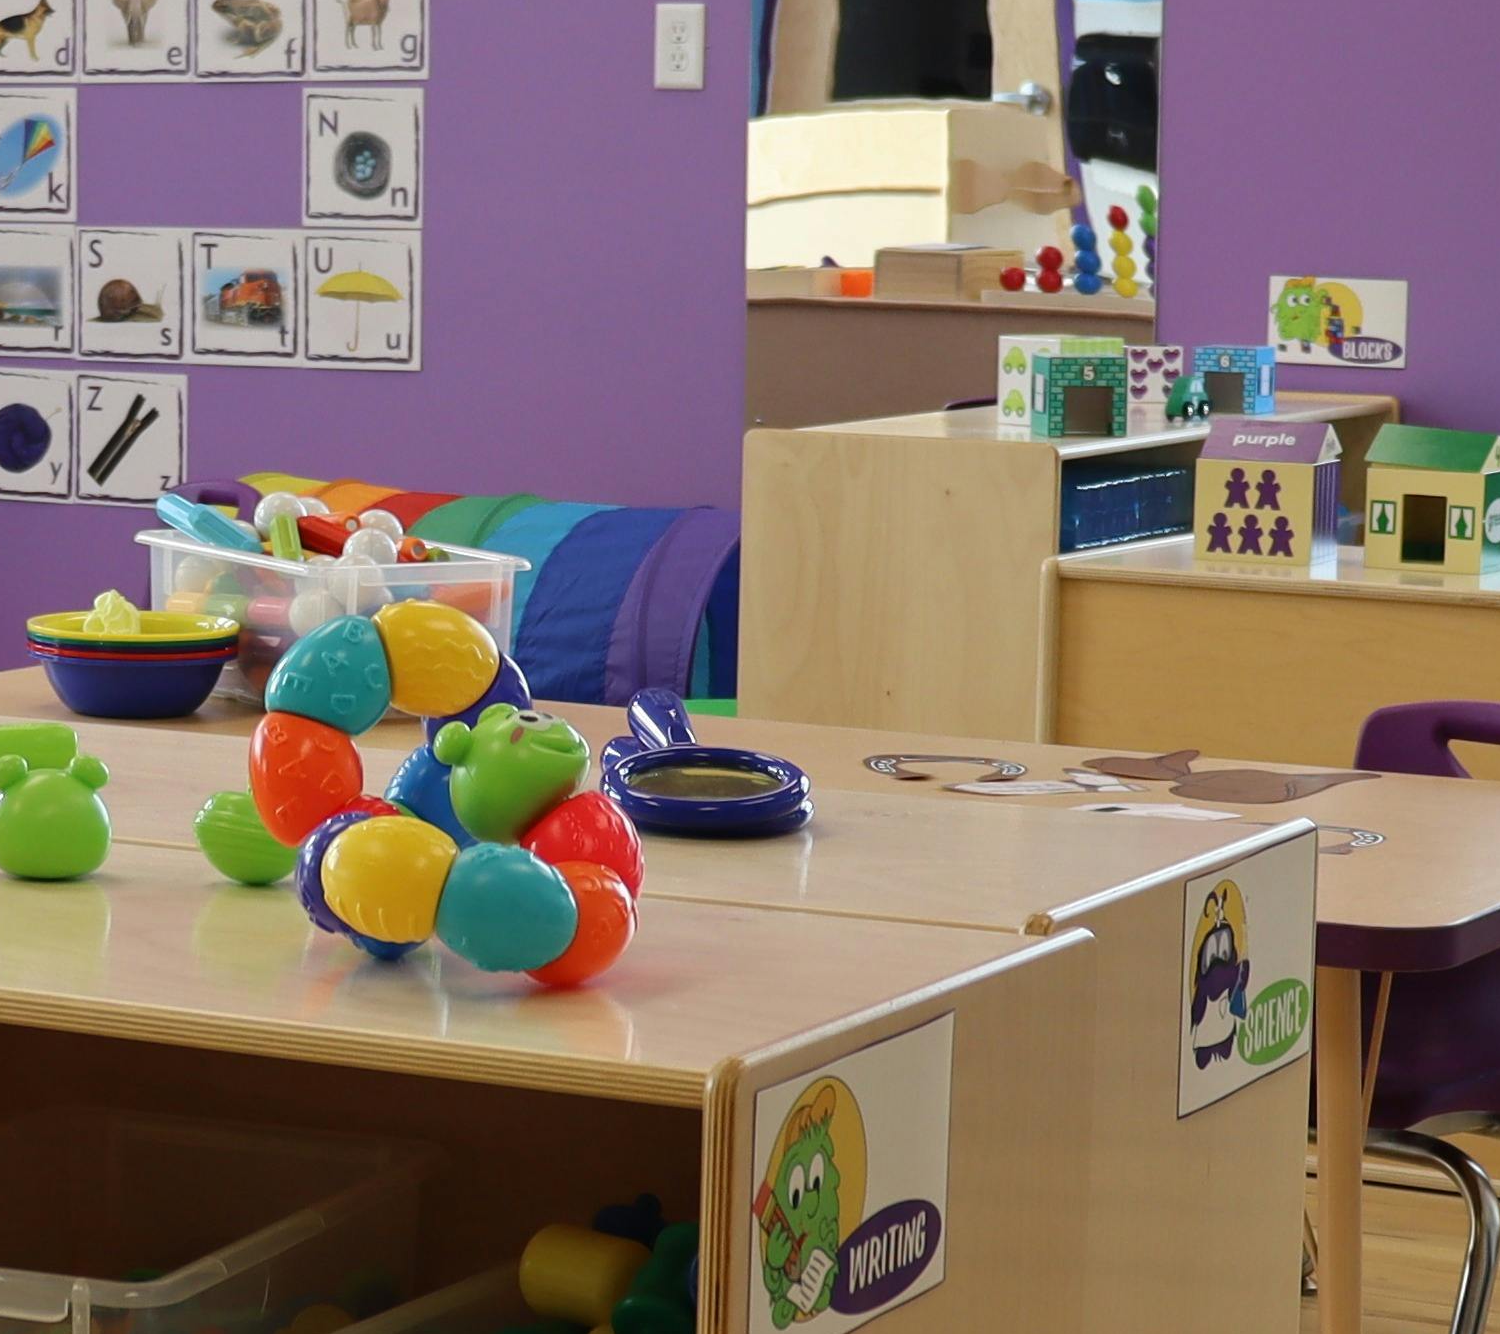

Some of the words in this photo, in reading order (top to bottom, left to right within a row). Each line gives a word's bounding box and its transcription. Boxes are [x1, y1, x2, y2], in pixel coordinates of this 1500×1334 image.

[55, 38, 69, 66] d
[167, 45, 183, 66] e
[284, 37, 297, 70] f
[400, 34, 417, 62] g
[319, 111, 338, 136] N
[48, 172, 64, 201] k
[391, 187, 408, 207] n
[89, 239, 103, 268] S
[200, 243, 218, 270] T
[314, 248, 332, 274] U
[161, 328, 172, 346] s
[278, 322, 288, 348] t
[386, 334, 401, 350] u
[1219, 354, 1230, 368] 6
[1342, 340, 1393, 362] BLOCKS
[1083, 365, 1095, 382] 5
[87, 386, 102, 411] Z
[1232, 431, 1297, 448] purple
[50, 462, 62, 484] y
[1243, 985, 1303, 1058] SCIENCE
[848, 1210, 926, 1295] WRITING
